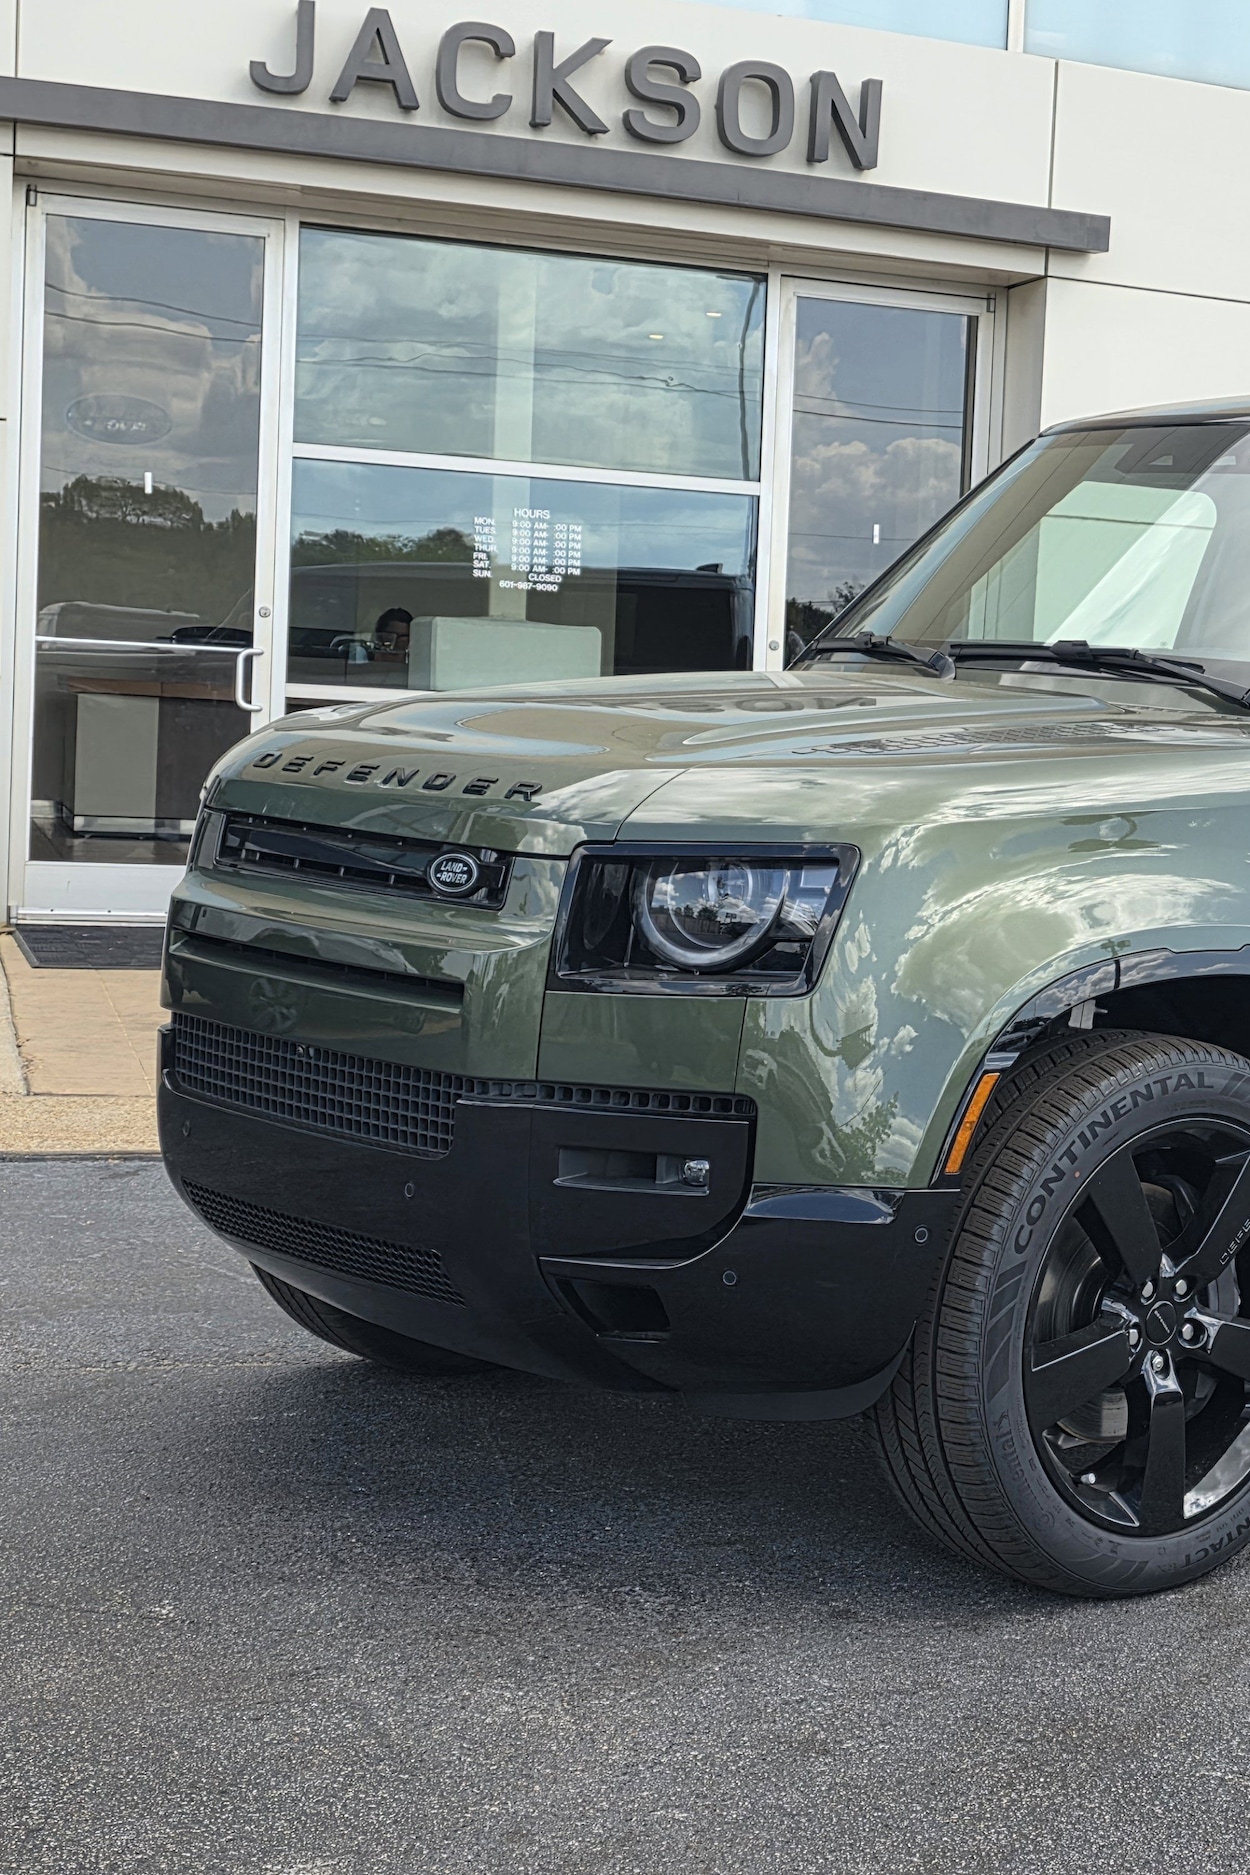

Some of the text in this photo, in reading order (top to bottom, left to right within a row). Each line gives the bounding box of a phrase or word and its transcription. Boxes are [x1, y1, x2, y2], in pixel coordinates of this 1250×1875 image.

[249, 0, 884, 170] JACKSON
[513, 508, 551, 519] HOURS
[569, 533, 581, 541] PM
[568, 550, 581, 558] PM
[568, 559, 580, 567] PM
[511, 563, 530, 572] 9:00
[568, 567, 580, 576] PM
[528, 573, 562, 582] CLOSED
[499, 580, 558, 592] 601-987-9090
[252, 752, 543, 801] DEFENDER
[1013, 1070, 1215, 1256] CONTINENTAL
